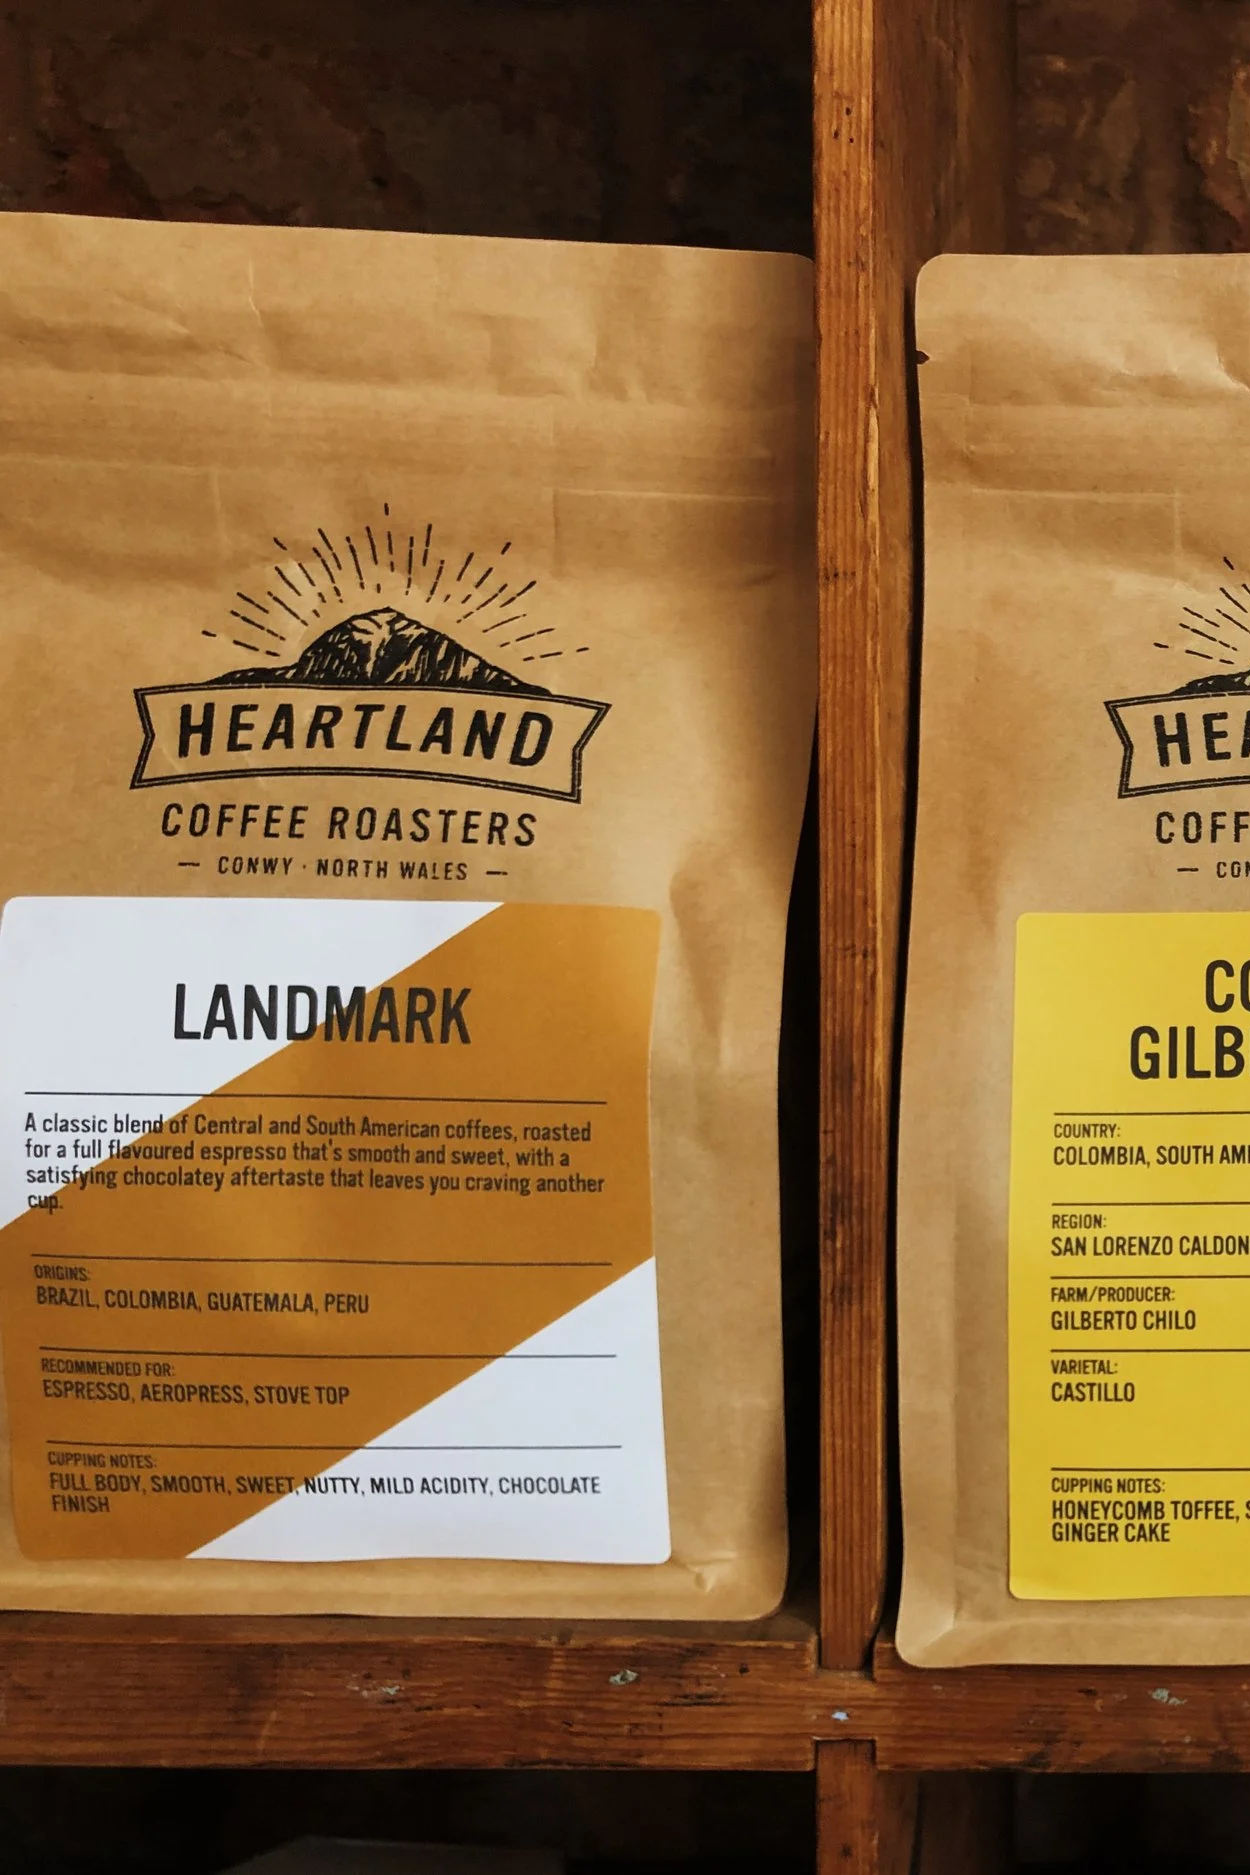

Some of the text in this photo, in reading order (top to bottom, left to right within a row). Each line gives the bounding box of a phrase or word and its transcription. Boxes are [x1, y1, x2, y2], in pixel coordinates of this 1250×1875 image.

[179, 702, 553, 766] HEARTLAND
[162, 803, 536, 846] COFFEE ROASTERS
[218, 856, 467, 880] CONWY NORTH WALES
[174, 983, 471, 1044] LANDMARK
[25, 1112, 591, 1142] A classic blend of Central and South American coffees, roasted
[1054, 1123, 1120, 1138] COUNTRY:
[25, 1138, 569, 1167] for a full flavoured espresso that's smooth and sweet, with a
[1054, 1146, 1150, 1168] COLOMBIA,
[1156, 1145, 1213, 1165] SOUTH
[27, 1164, 604, 1196] satisfying chocolatey aftertaste that leaves you craving another
[28, 1195, 63, 1214] cup.
[1052, 1214, 1106, 1229] REGION:
[1051, 1237, 1086, 1256] SAN
[1093, 1236, 1173, 1256] LORENZO
[34, 1264, 91, 1281] ORIGINS:
[37, 1286, 368, 1314] BRAZIL, COLOMBIA, GUATEMALA, PERU
[1051, 1286, 1174, 1302] FARM/PRODUCER:
[1052, 1310, 1195, 1330] GILBERTO CHILO
[41, 1358, 174, 1377] RECOMMENDED FOR:
[1051, 1359, 1117, 1374] VARIETAL:
[43, 1379, 349, 1405] ESPRESSO, AEROPRESS, STOVE TOP
[1052, 1382, 1135, 1402] CASTILLO
[48, 1451, 156, 1469] CUPPING NOTES:
[50, 1472, 600, 1496] FULL BODY, SMOOTH, SWEET, NUTTY, MILD ACIDITY, CHOCOLATE
[1052, 1477, 1164, 1493] CUPPING NOTES:
[52, 1495, 109, 1513] FINISH
[1053, 1500, 1165, 1520] HONEYCOMB
[1170, 1500, 1239, 1522] TOFFEE,
[1052, 1522, 1170, 1542] GINGER CAKE
